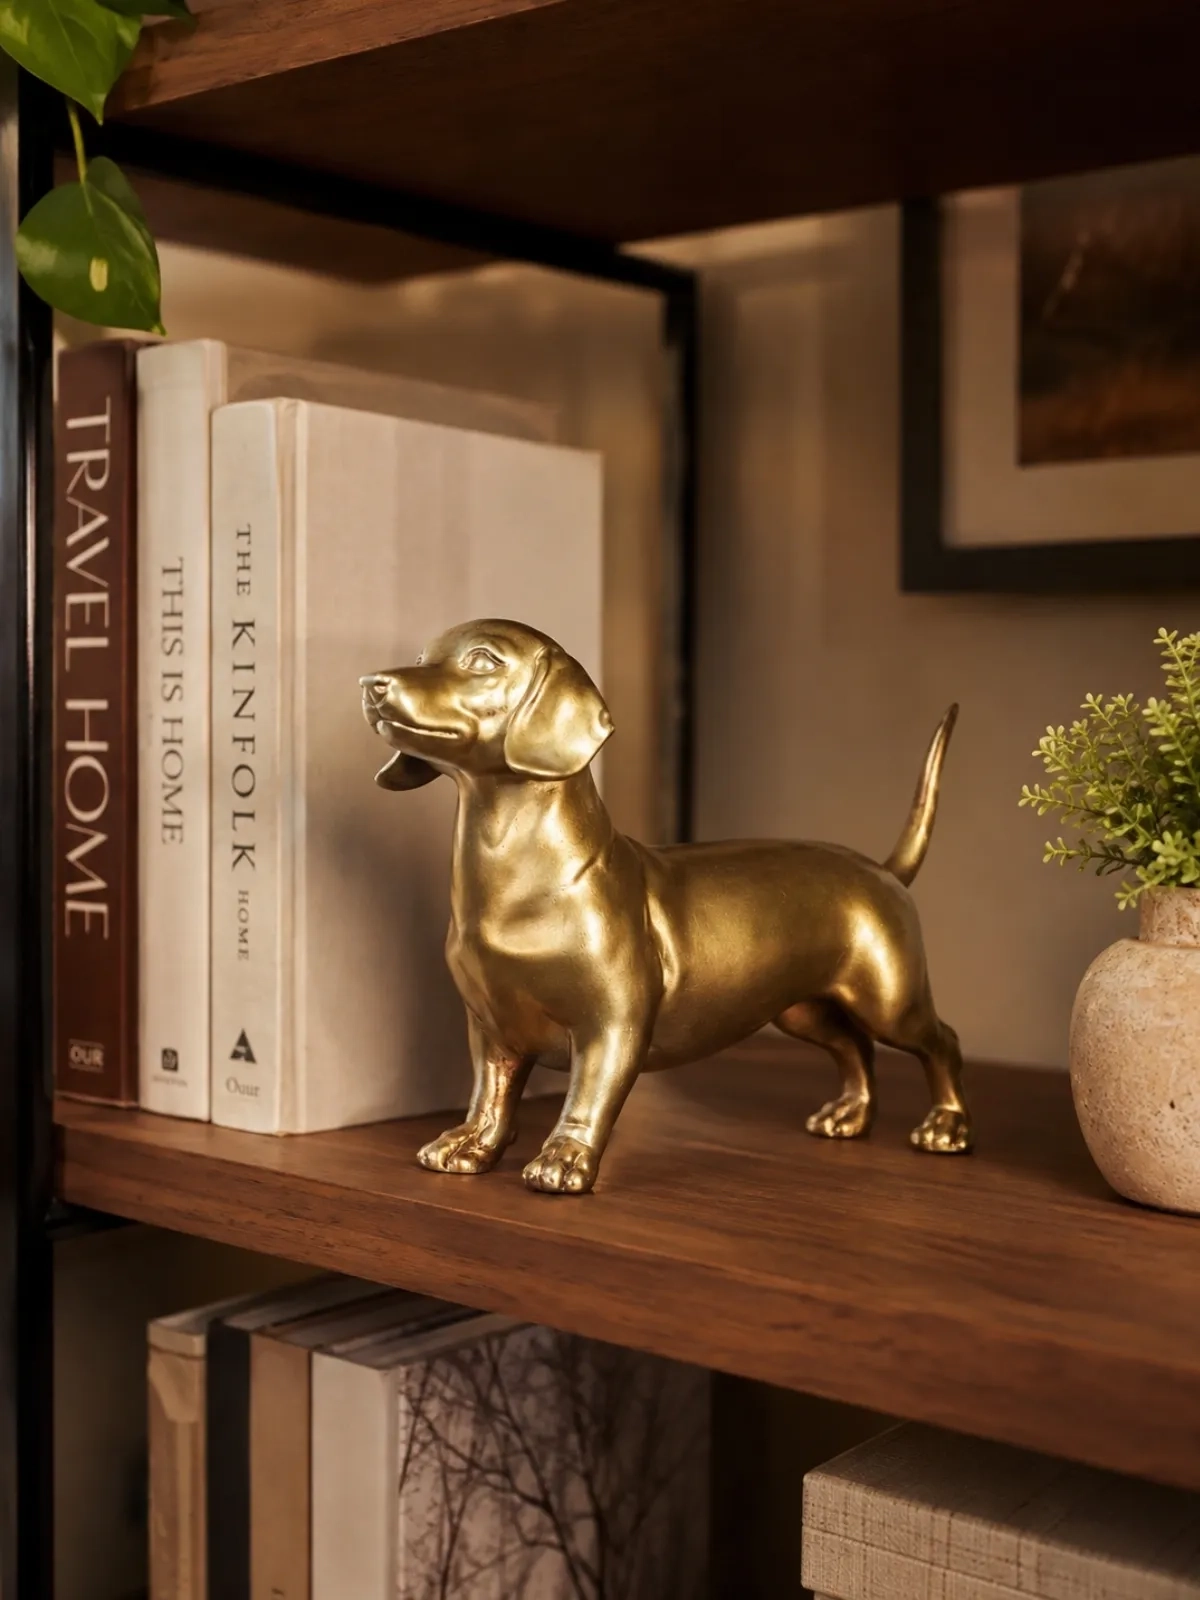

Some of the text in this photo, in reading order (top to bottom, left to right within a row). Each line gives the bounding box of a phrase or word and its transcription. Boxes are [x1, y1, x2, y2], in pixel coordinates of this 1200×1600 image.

[65, 396, 110, 940] TRAVEL HOME
[161, 556, 184, 846] THIS IS HOME
[231, 523, 256, 961] THE KINFOLK HOME
[69, 1045, 104, 1067] OUR
